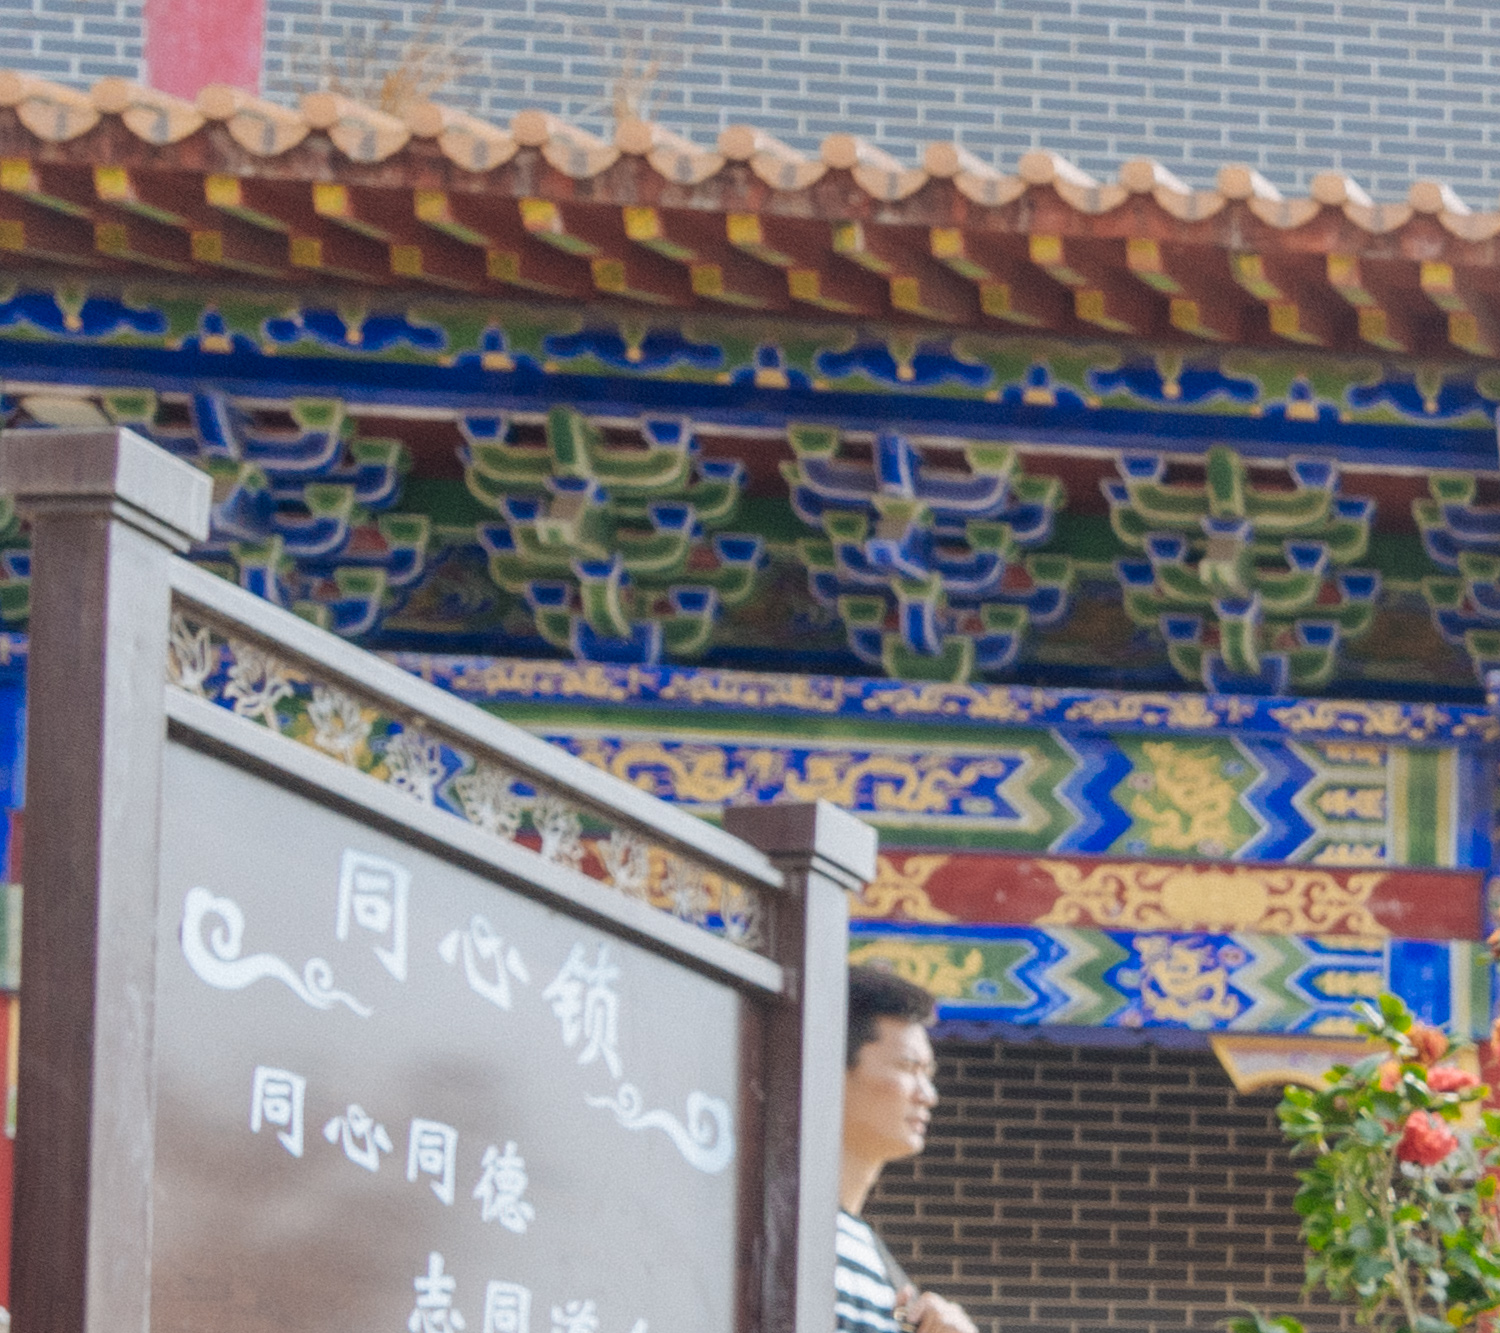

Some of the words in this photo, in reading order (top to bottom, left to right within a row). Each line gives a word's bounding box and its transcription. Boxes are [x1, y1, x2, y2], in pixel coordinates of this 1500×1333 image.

[335, 847, 623, 1078] 同心锁
[250, 1066, 536, 1234] 同心同德
